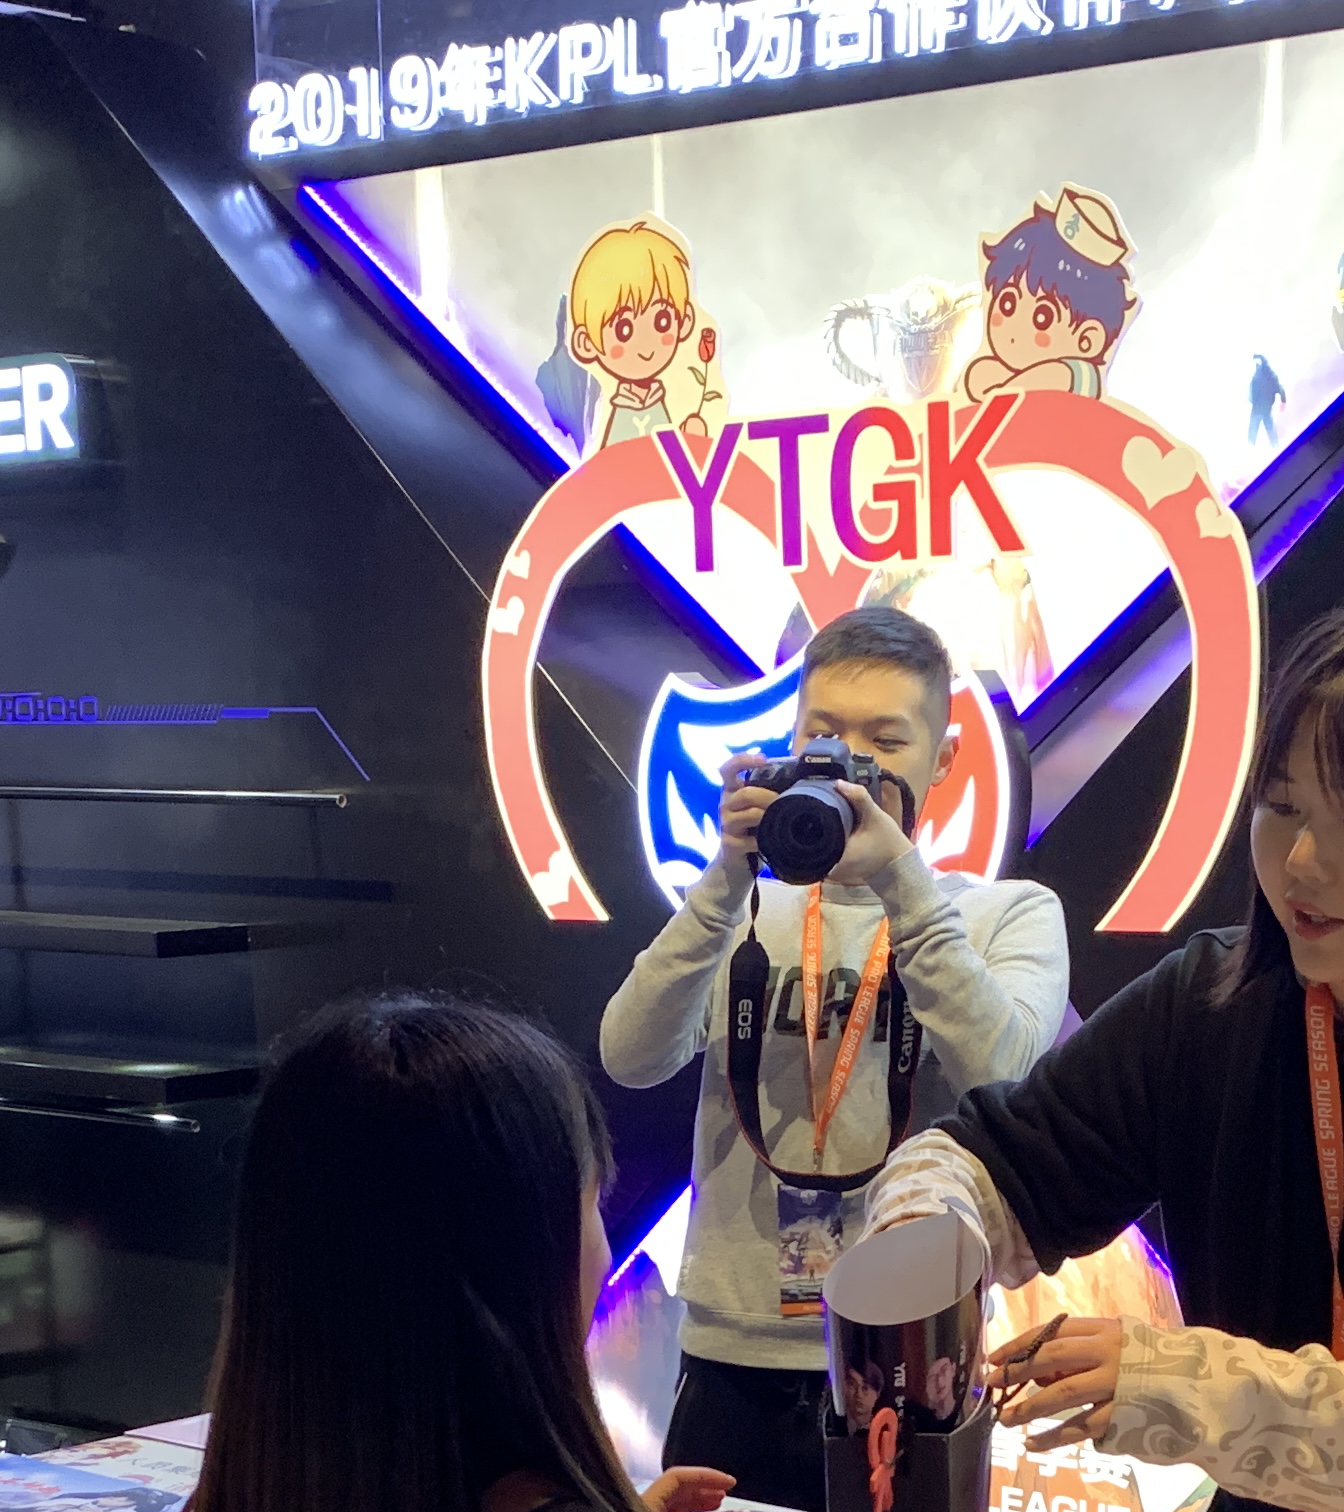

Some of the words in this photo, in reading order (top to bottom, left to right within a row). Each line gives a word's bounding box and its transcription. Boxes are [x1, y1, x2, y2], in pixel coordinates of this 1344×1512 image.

[656, 394, 1026, 572] YTGK
[737, 998, 753, 1040] EOS
[1309, 1005, 1329, 1072] SEASON
[1314, 1078, 1336, 1141] SPRING
[1322, 1148, 1340, 1210] LEAGUE
